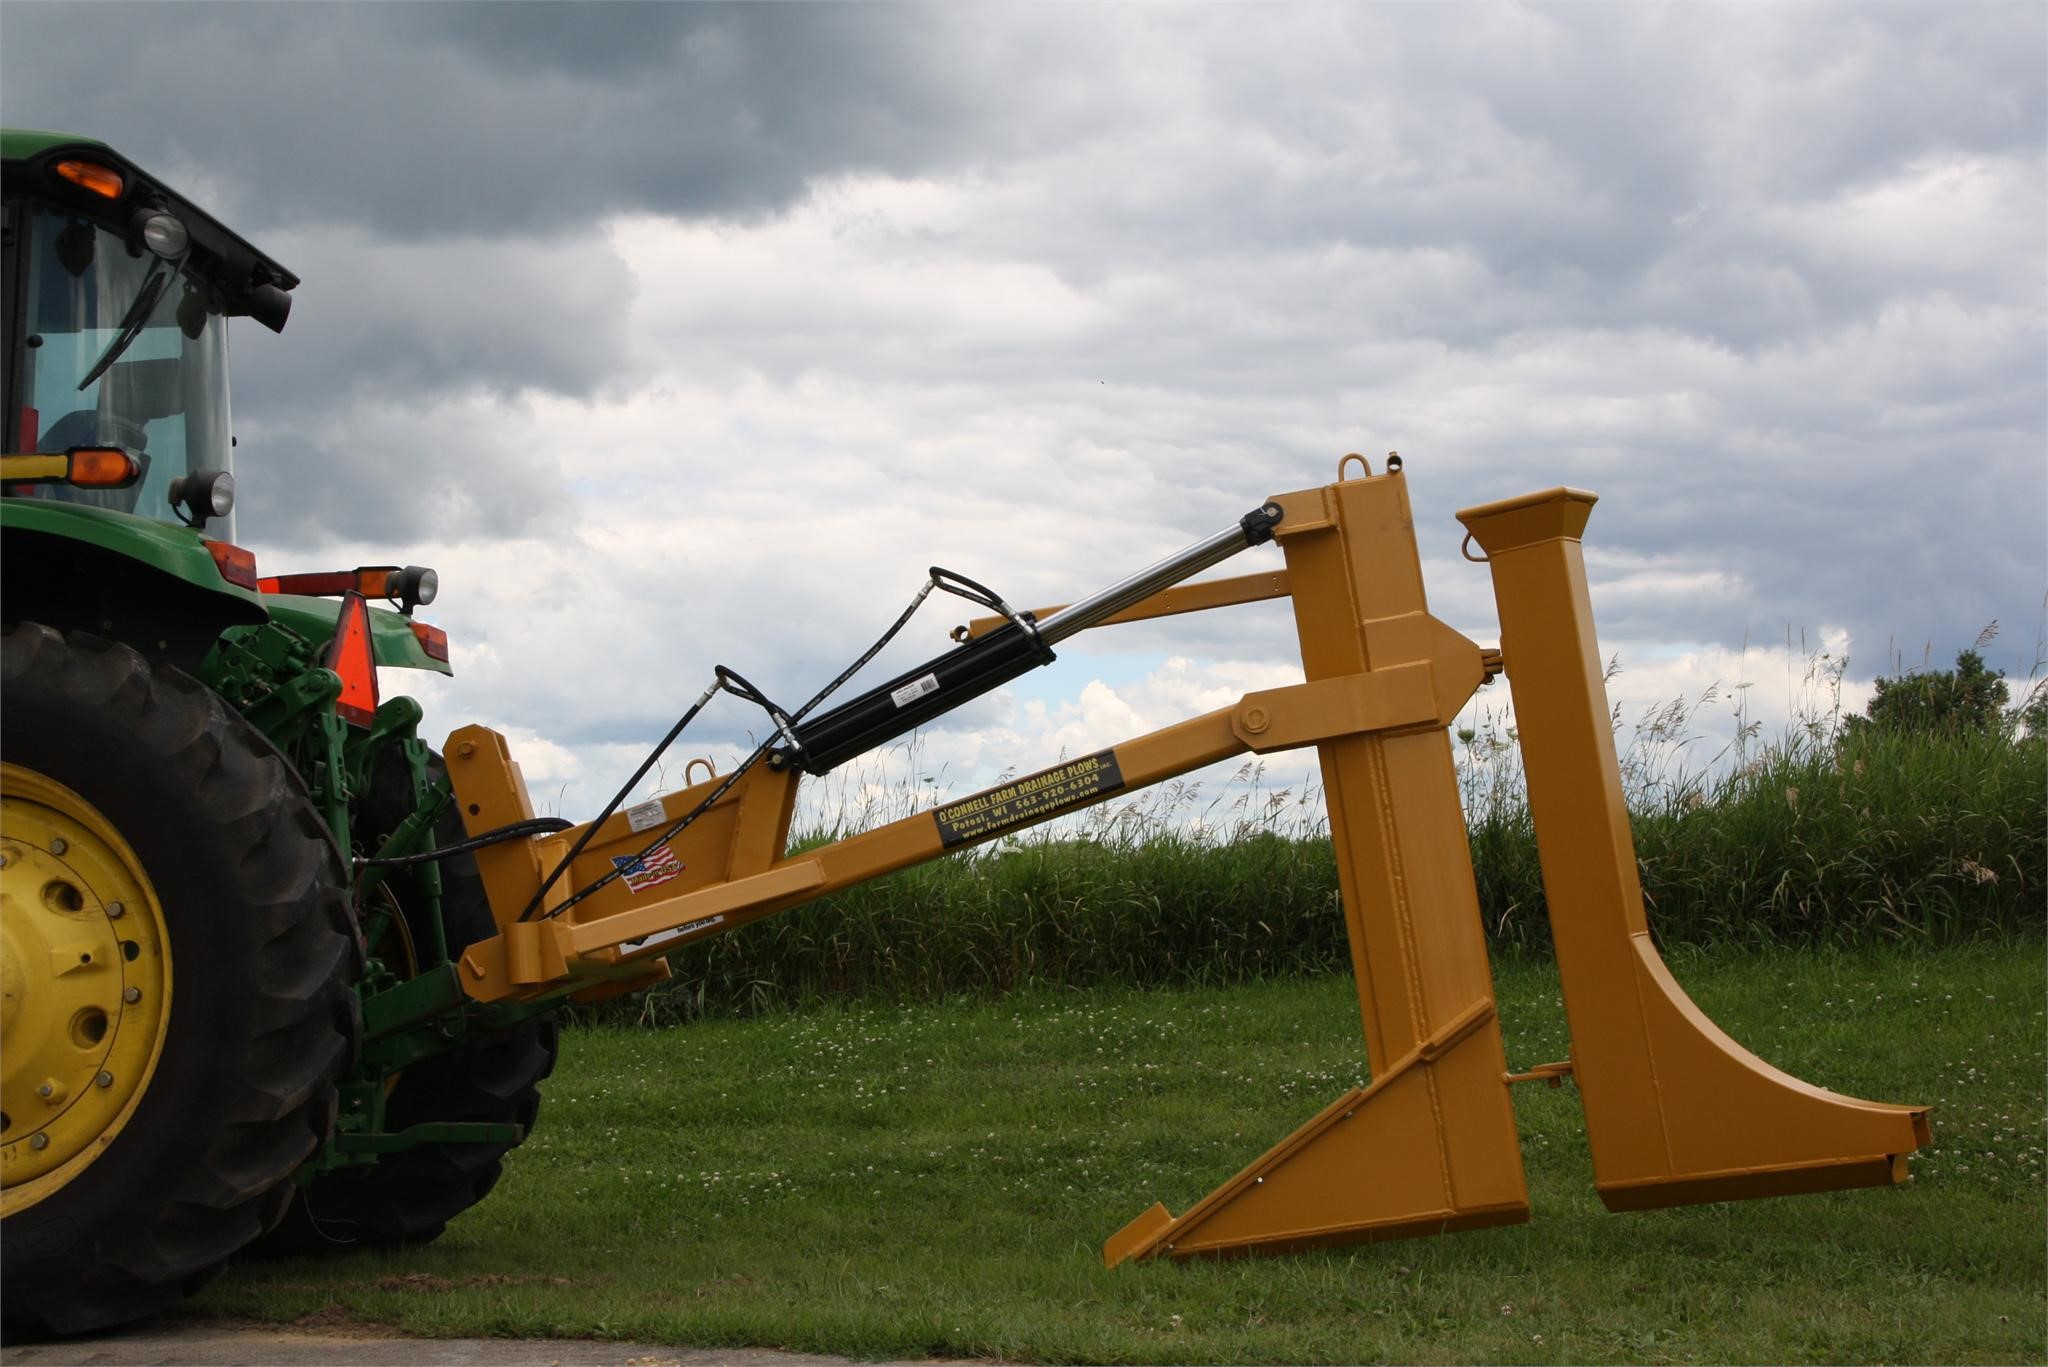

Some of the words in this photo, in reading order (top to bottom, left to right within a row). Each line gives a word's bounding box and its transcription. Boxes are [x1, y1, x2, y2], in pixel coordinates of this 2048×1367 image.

[940, 796, 989, 822] O'CONNELL
[991, 787, 1017, 804] FARM
[1018, 769, 1066, 795] DRAINAGE
[1067, 758, 1099, 778] PLOWS
[952, 815, 990, 832] Potosi,
[992, 806, 1008, 818] WI
[1016, 773, 1099, 809] 563-920-6304
[963, 786, 1099, 839] www.farmdrainageplows.com
